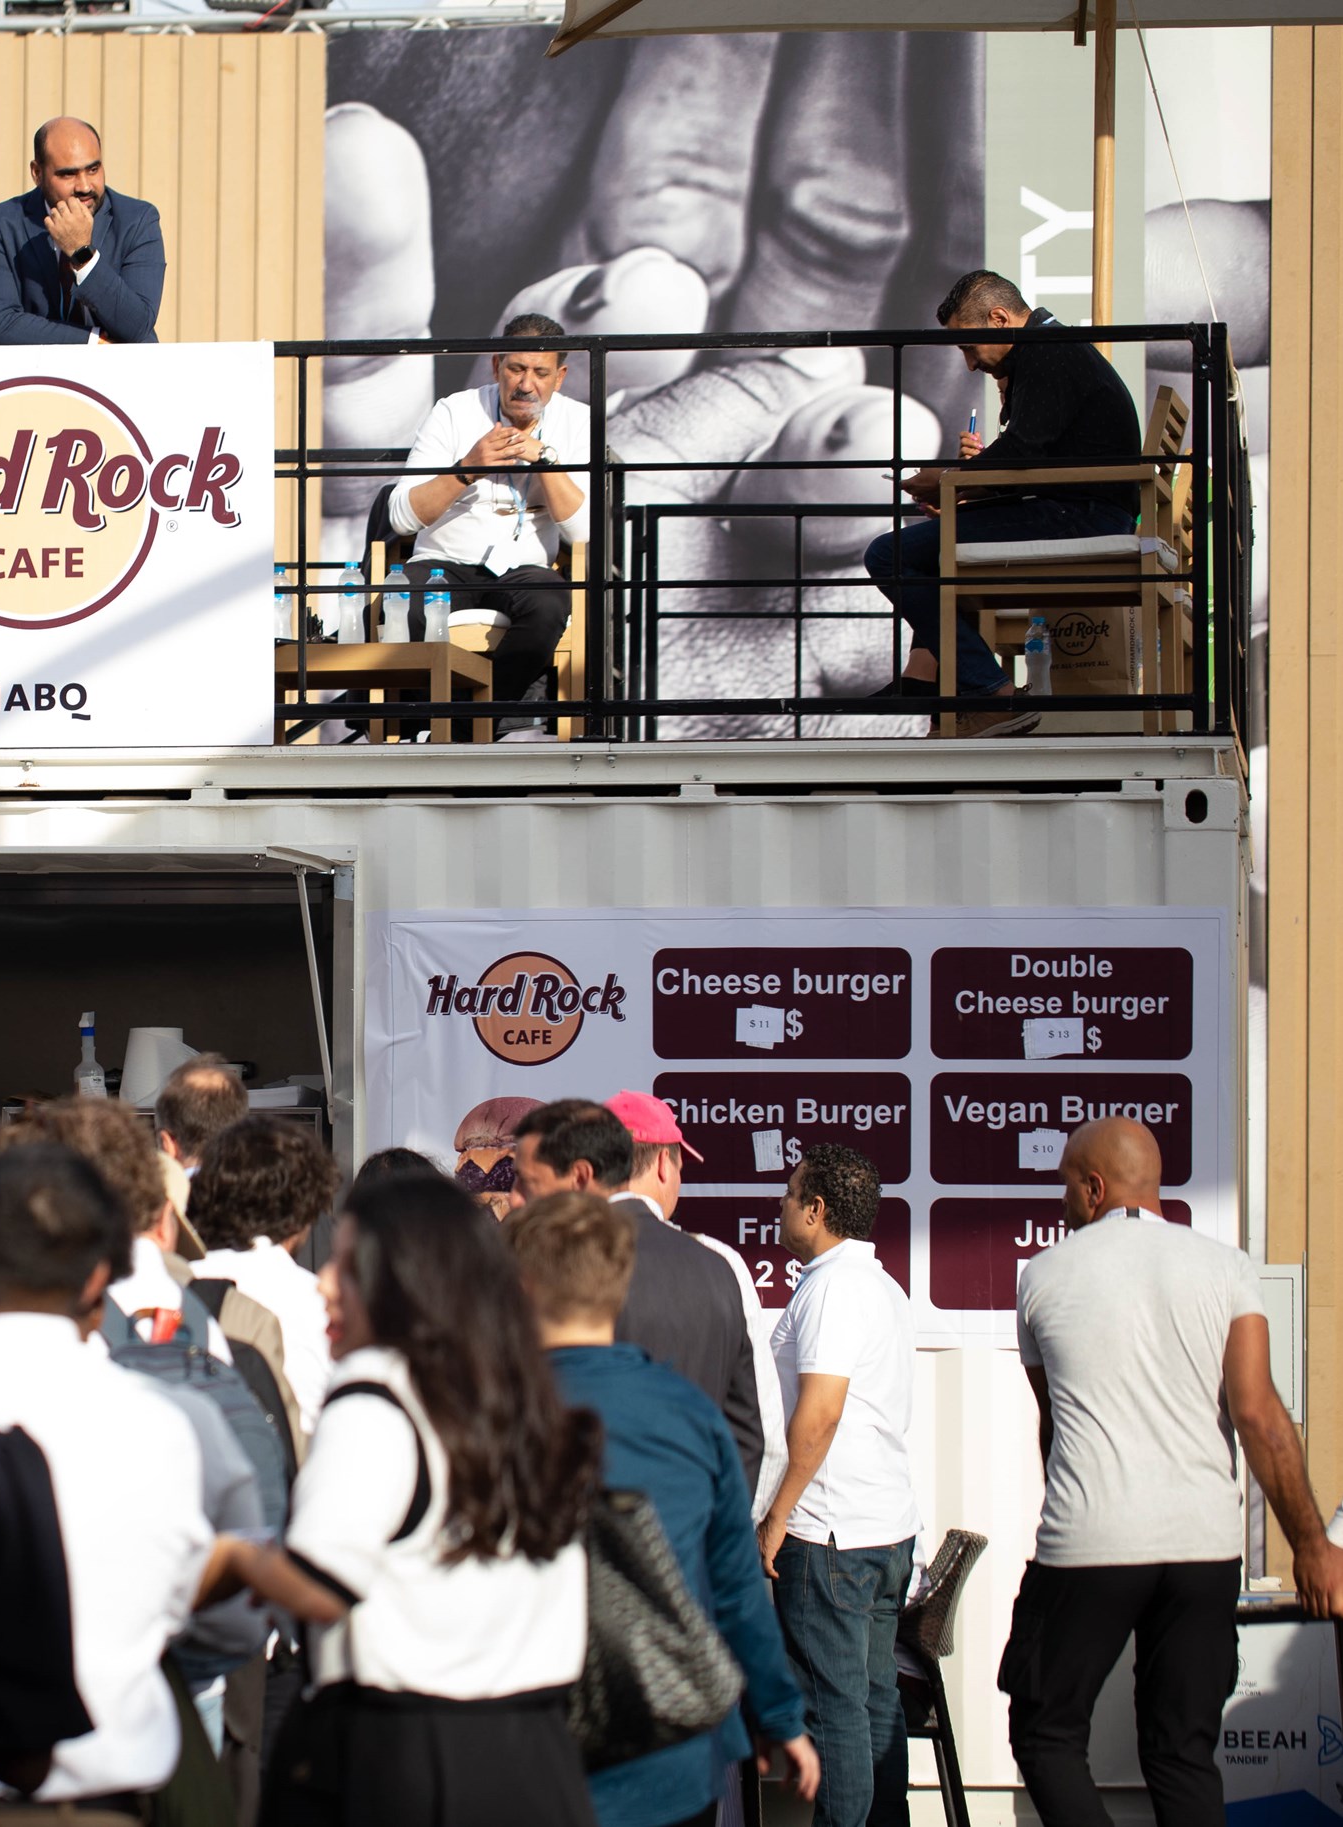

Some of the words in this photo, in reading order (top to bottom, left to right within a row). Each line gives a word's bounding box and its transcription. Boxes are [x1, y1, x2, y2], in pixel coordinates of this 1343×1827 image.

[41, 426, 243, 532] Rock
[1075, 620, 1110, 639] Rock
[1066, 641, 1085, 649] CAFE
[1011, 954, 1113, 978] Double
[426, 973, 527, 1016] Hard
[530, 973, 627, 1023] Rock
[656, 968, 781, 995] Cheese
[793, 968, 906, 1002] burger
[955, 990, 1063, 1015] Cheese
[1072, 991, 1170, 1021] burger
[503, 1029, 552, 1045] CAFE
[785, 1008, 804, 1040] $
[1058, 1030, 1069, 1039] 13
[1086, 1025, 1103, 1053] $
[796, 1098, 906, 1131] Burger
[943, 1095, 1048, 1130] Vegan
[785, 1137, 803, 1167] $
[1041, 1144, 1054, 1154] 10
[738, 1217, 781, 1245] Fri
[1014, 1219, 1071, 1247] Jui
[755, 1260, 774, 1287] 2
[1224, 1730, 1307, 1749] BEEAH
